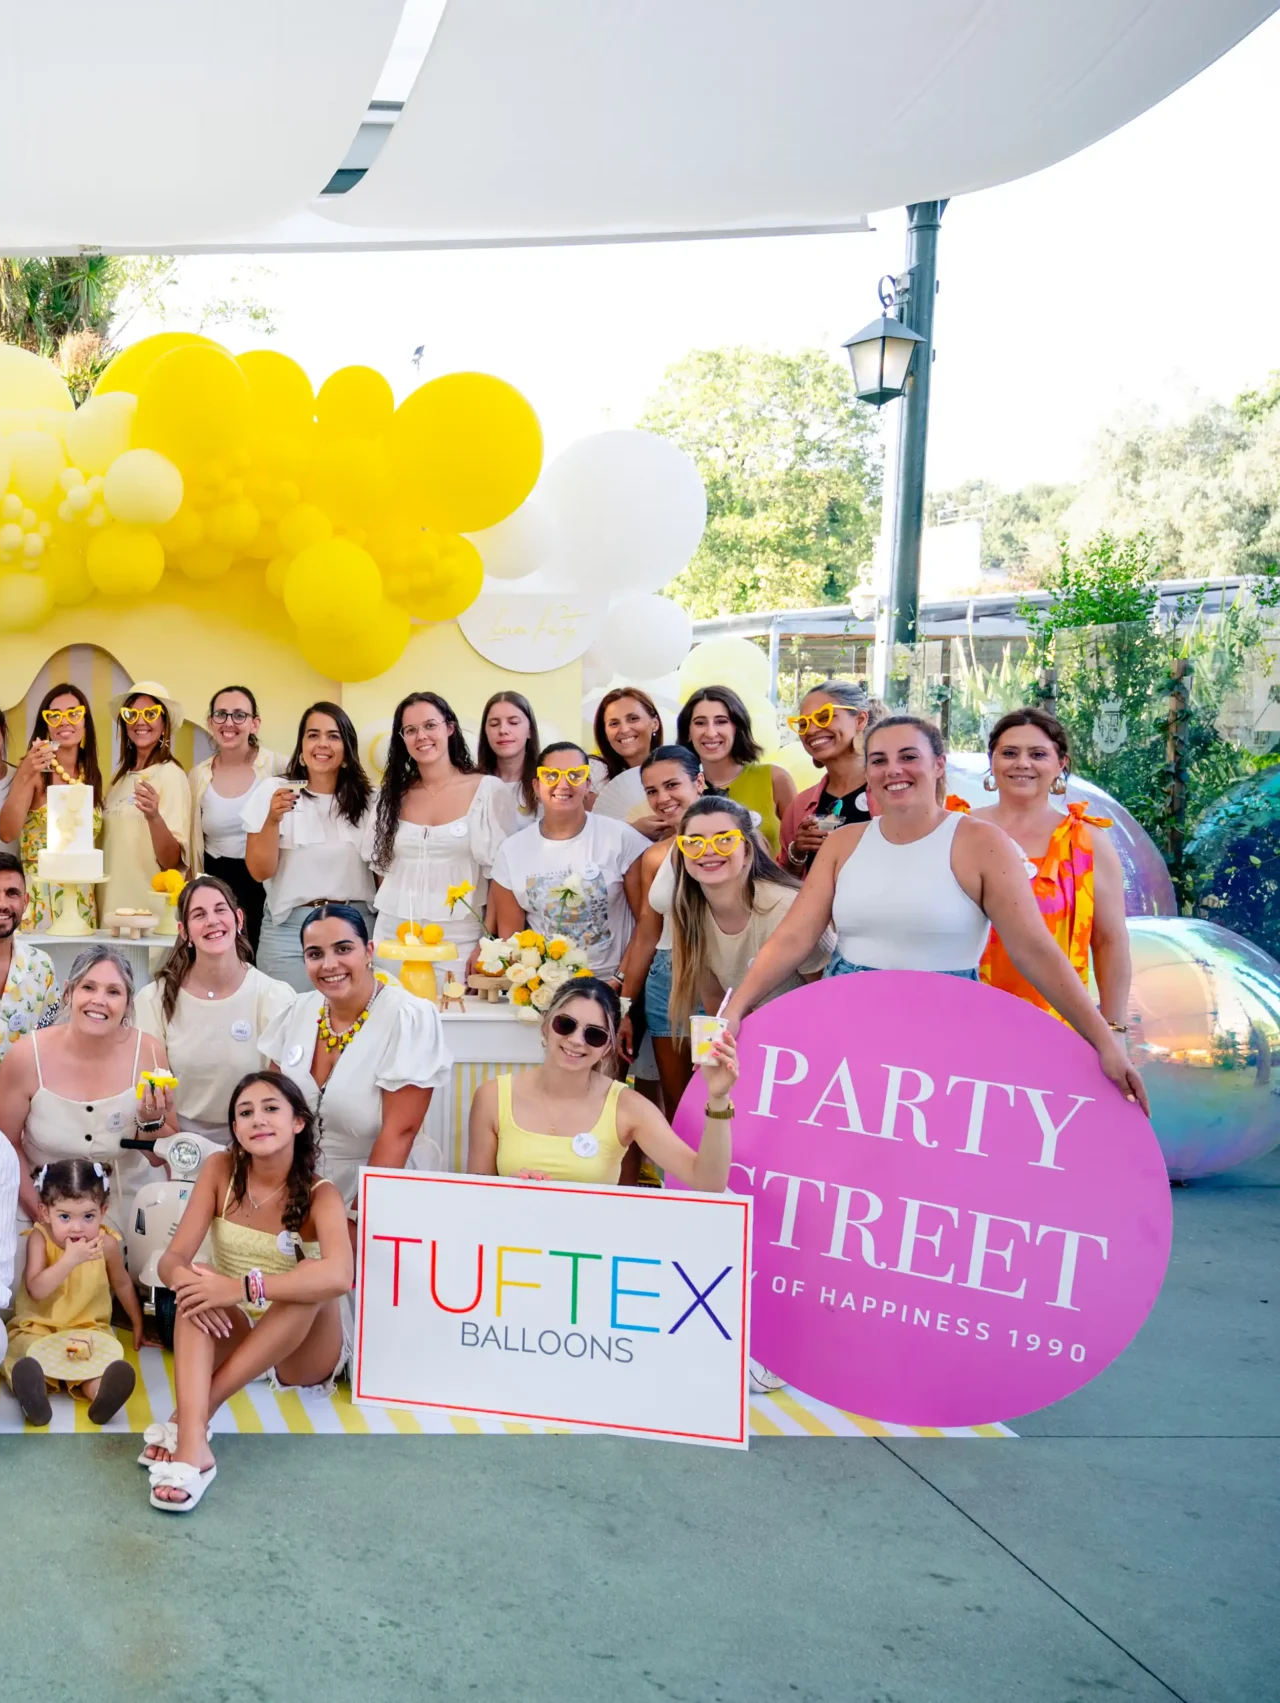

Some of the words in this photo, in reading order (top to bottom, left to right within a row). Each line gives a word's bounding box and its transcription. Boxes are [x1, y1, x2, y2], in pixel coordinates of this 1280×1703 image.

[748, 1043, 1096, 1171] PARTY
[372, 1234, 734, 1341] TUFTEX
[771, 1275, 806, 1298] OF
[819, 1285, 991, 1342] HAPPINESS
[1007, 1329, 1087, 1363] 1990
[460, 1321, 635, 1364] BALLOONS
